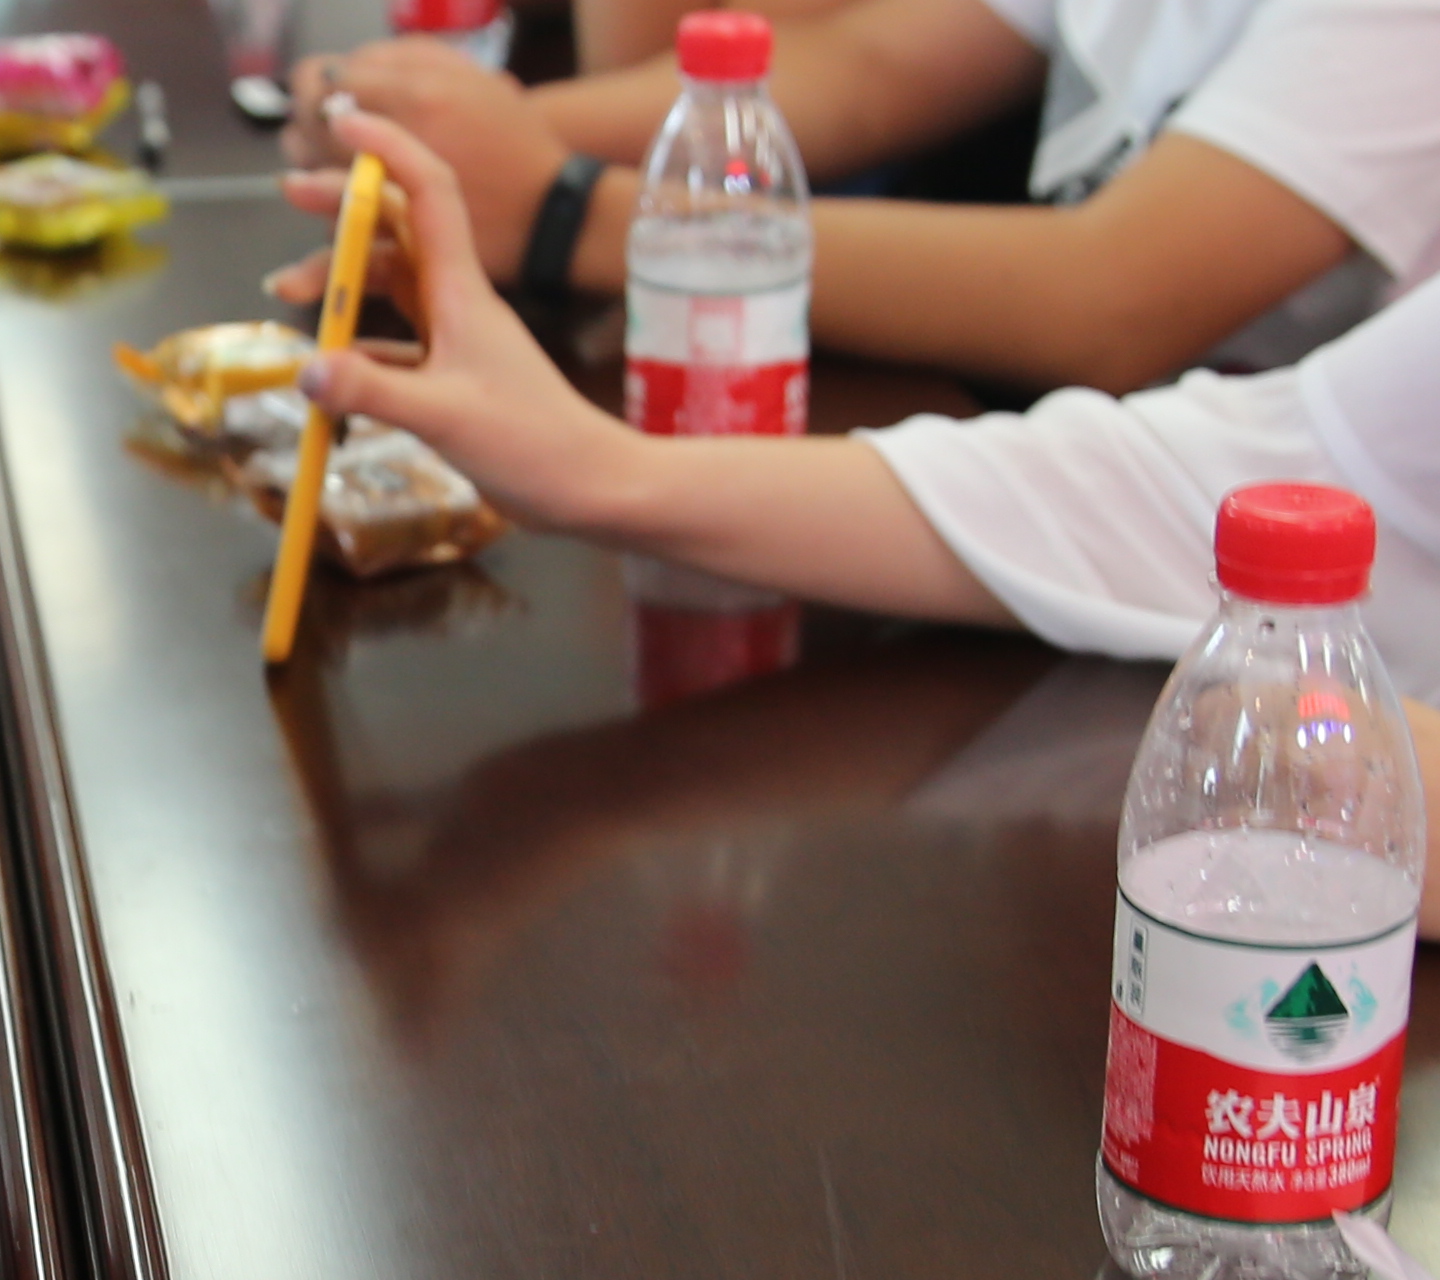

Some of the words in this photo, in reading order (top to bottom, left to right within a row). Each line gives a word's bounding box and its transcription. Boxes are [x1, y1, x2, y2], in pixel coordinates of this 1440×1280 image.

[1205, 1084, 1377, 1139] 农夫山泉
[1204, 1133, 1297, 1168] NONGFU
[1305, 1126, 1372, 1166] SPRING
